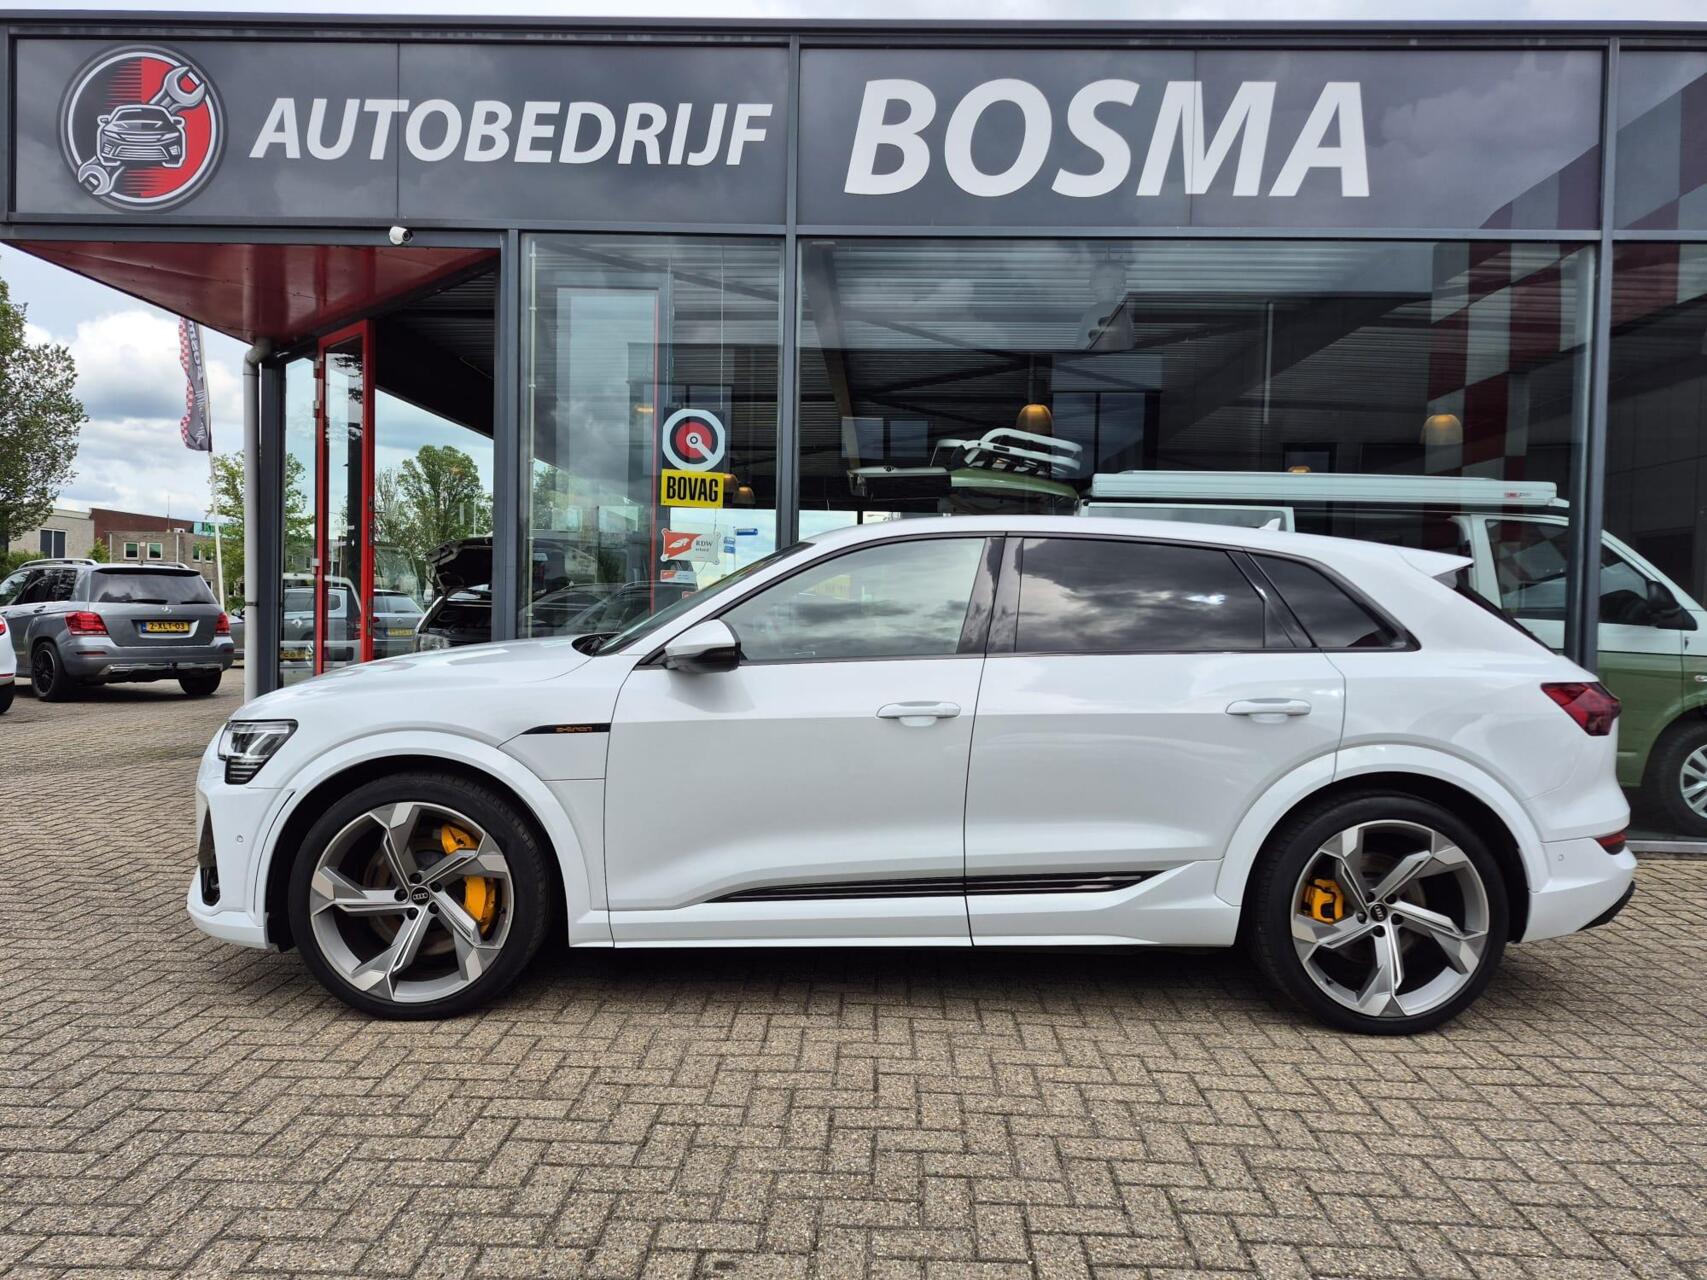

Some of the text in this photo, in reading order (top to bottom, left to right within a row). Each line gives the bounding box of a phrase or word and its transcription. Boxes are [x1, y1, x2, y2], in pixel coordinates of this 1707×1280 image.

[249, 97, 774, 167] AUTOBEDRIJF
[844, 78, 1370, 198] BOSMA
[666, 475, 719, 502] BOVAG
